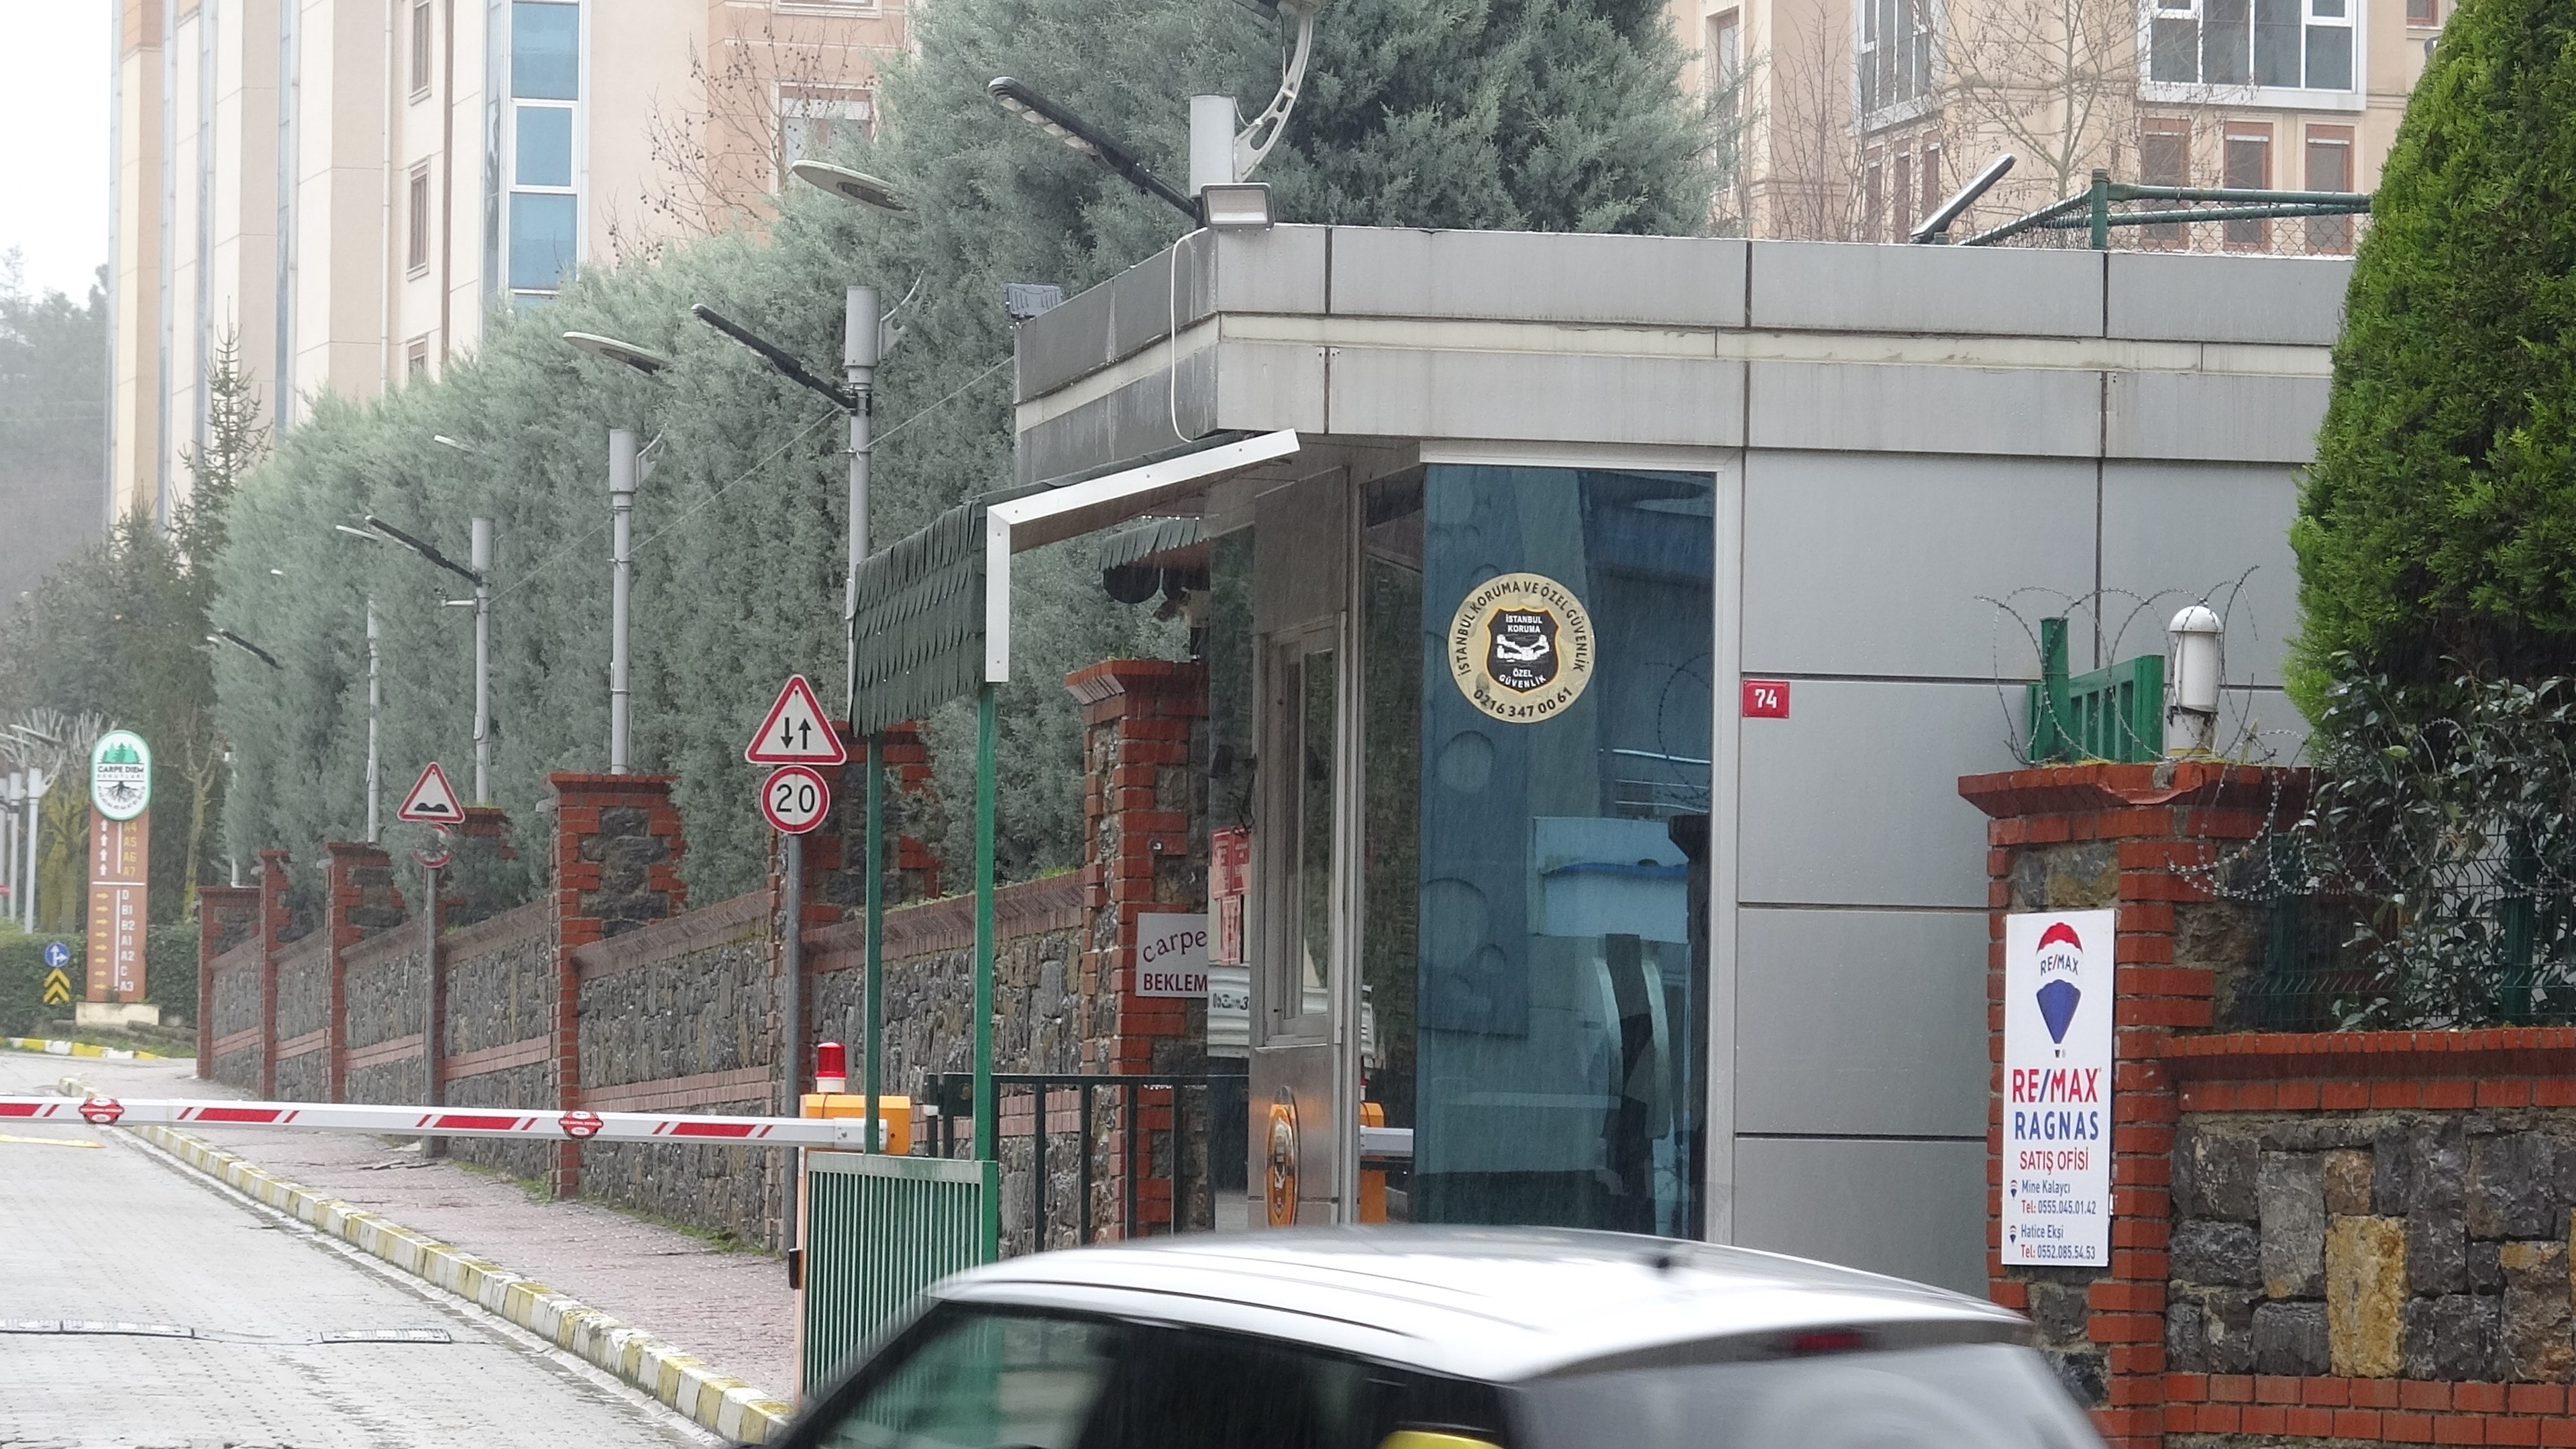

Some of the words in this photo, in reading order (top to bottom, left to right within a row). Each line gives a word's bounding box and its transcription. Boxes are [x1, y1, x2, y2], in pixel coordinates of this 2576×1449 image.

[1505, 614, 1543, 624] İSTANBUL
[1456, 614, 1476, 677] İSTANBUL
[1470, 581, 1521, 614] KORUMA
[1523, 581, 1540, 594] VE
[1540, 582, 1569, 611] ÖZEL
[1566, 609, 1590, 673] GÜVENLİK
[1507, 625, 1541, 633] KORUMA
[1512, 667, 1534, 678] ÖZEL
[1499, 674, 1547, 688] GÜVENLİK
[1473, 689, 1505, 715] 0216
[1508, 705, 1534, 718] 347
[1538, 698, 1556, 714] 00
[1557, 686, 1573, 703] 61
[1755, 688, 1778, 709] 74
[776, 784, 816, 814] 20
[121, 905, 133, 916] B1
[121, 920, 136, 931] B2
[121, 935, 133, 946] A1
[1142, 930, 1208, 963] carpe
[120, 950, 135, 961] A2
[120, 965, 128, 977] C
[2040, 953, 2079, 976] RE/MAX
[119, 981, 134, 992] A3
[2012, 1068, 2099, 1103] RE/MAX
[2015, 1110, 2099, 1140] RAGNAS
[2019, 1150, 2054, 1175] SATIŞ
[2057, 1146, 2089, 1171] OFİSİ
[2021, 1179, 2041, 1194] Mine
[2042, 1179, 2071, 1197] Kalaycı
[2021, 1199, 2037, 1214] Tel:
[2037, 1200, 2096, 1215] 0555.045.01.42
[2021, 1224, 2046, 1238] Hatice
[2047, 1224, 2064, 1241] Ekşi
[2021, 1244, 2036, 1258] Tel:
[2037, 1244, 2096, 1260] 0552.085.54.53
